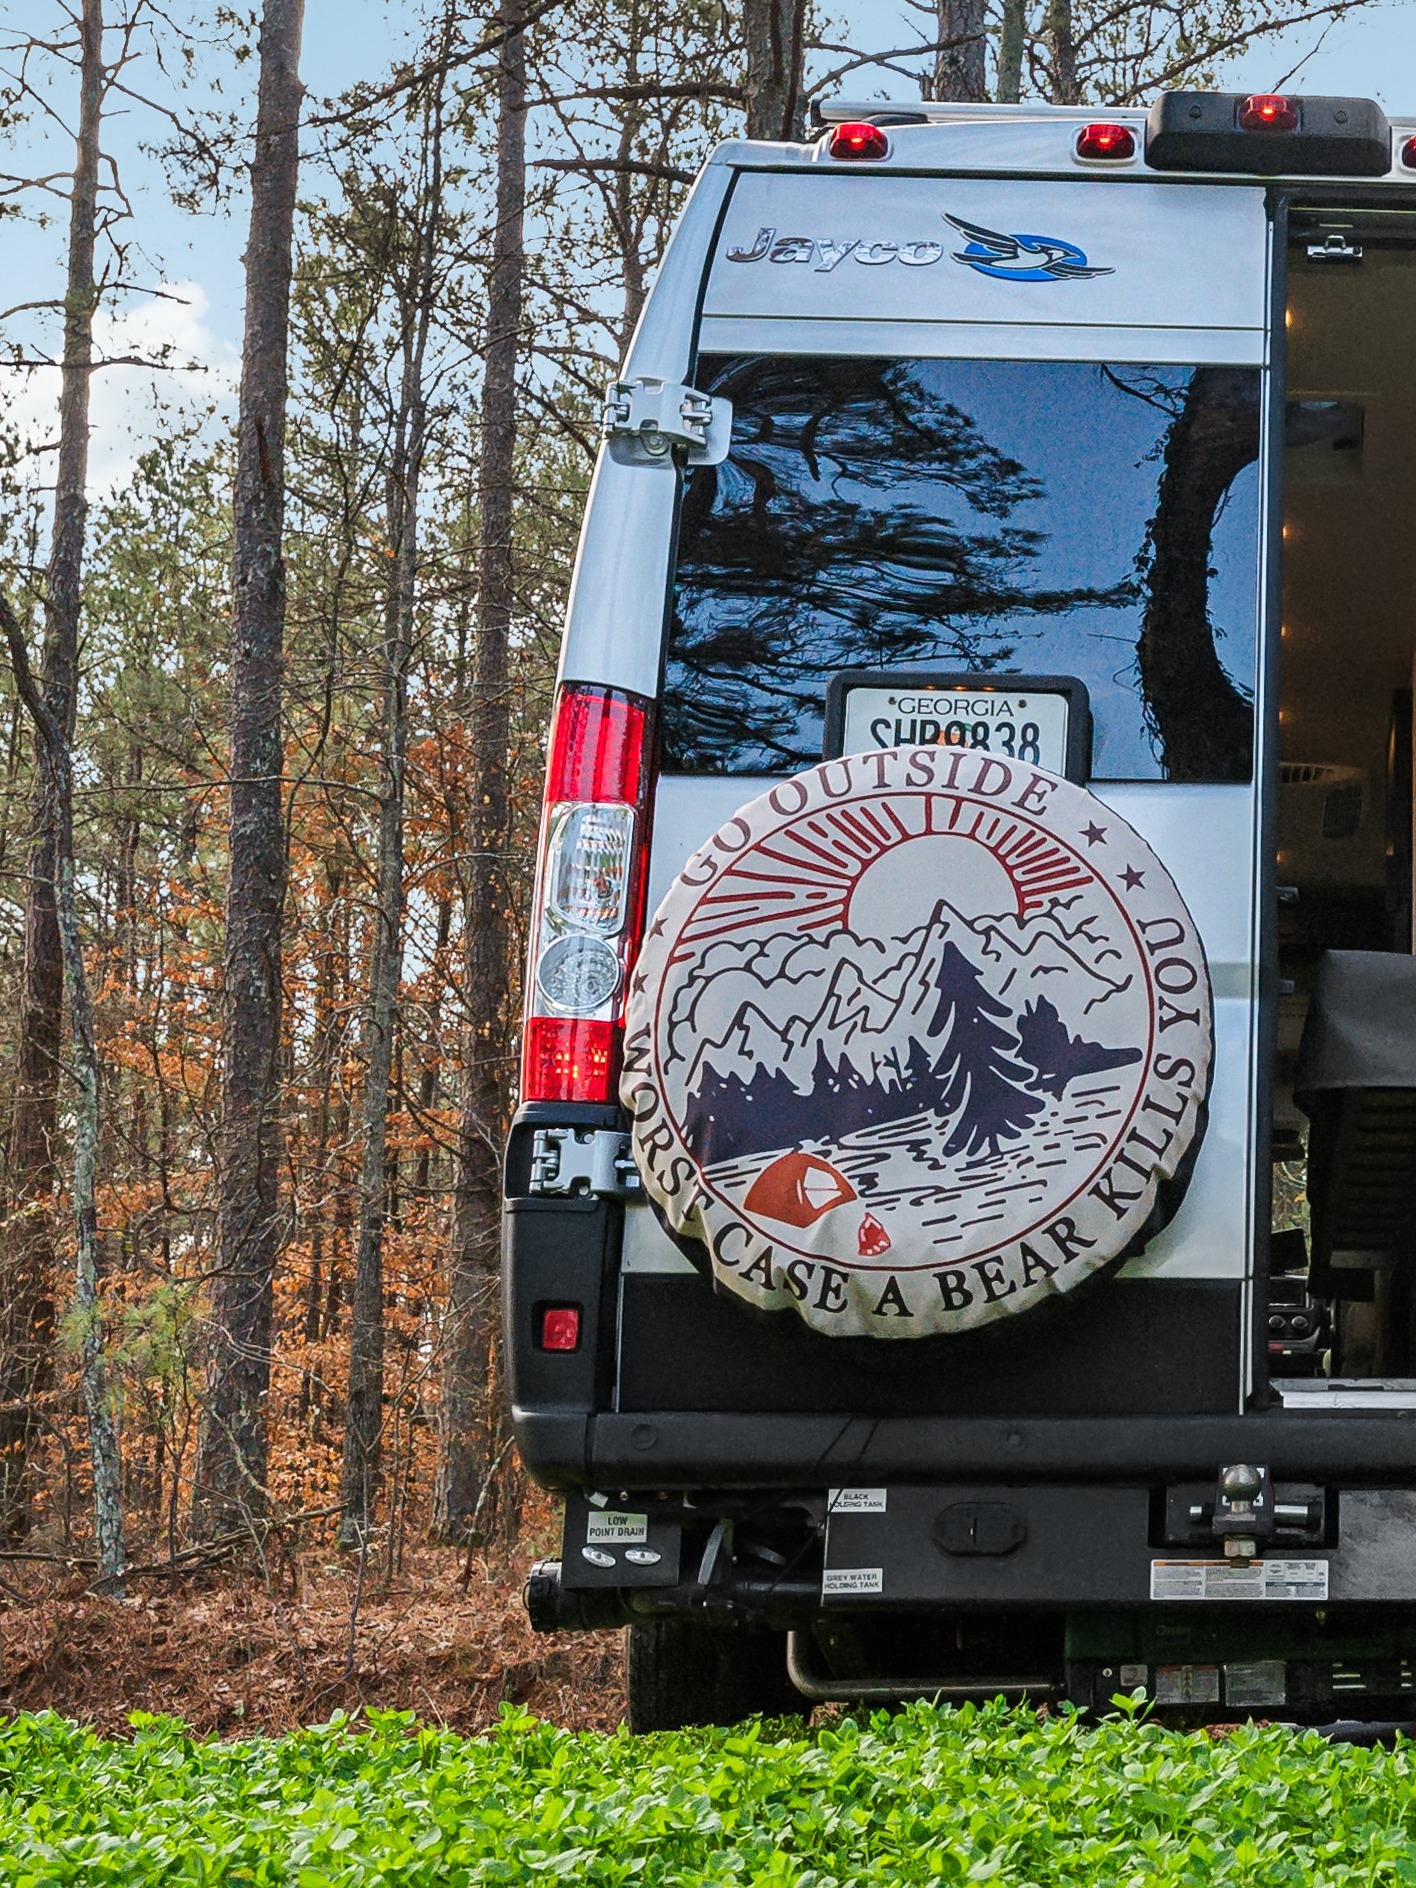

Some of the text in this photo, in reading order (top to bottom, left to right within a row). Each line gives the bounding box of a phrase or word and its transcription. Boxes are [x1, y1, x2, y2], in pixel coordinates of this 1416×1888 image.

[725, 227, 944, 273] Jayco
[897, 697, 1014, 717] GEORGIA
[680, 749, 1058, 887] GO OUTSIDE
[622, 917, 1201, 1317] WORST CASE A BEAR KILLS YOU
[607, 1516, 628, 1526] LOW
[589, 1527, 645, 1537] POINT DRAIN
[860, 1580, 880, 1588] TANK
